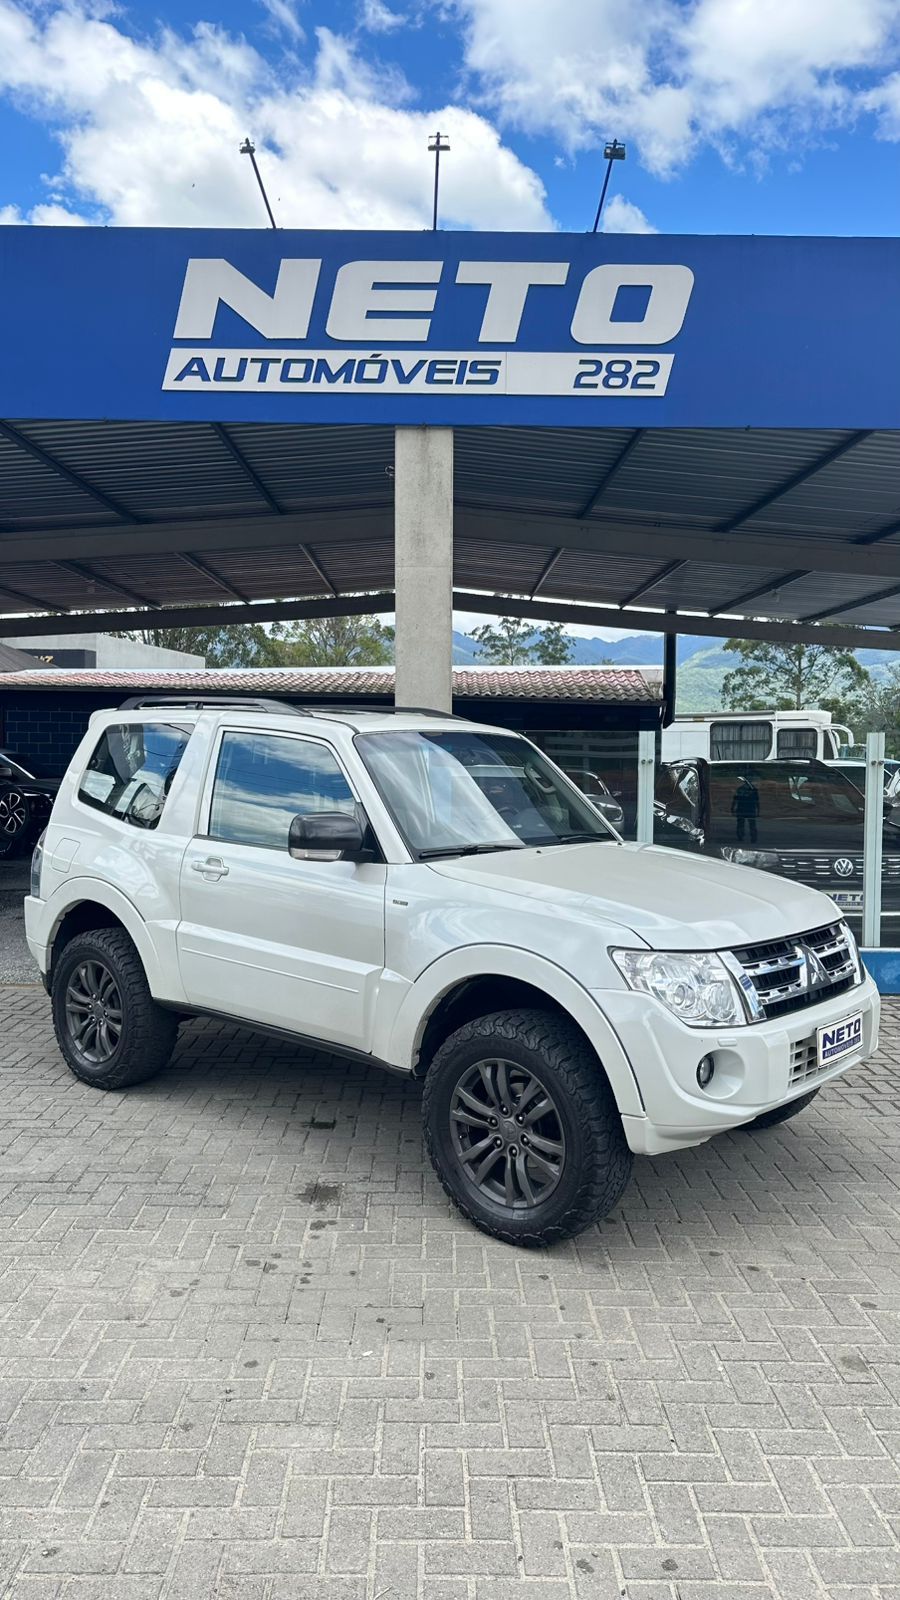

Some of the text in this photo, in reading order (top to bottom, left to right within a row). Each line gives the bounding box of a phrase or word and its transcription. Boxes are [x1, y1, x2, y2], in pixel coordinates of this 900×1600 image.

[173, 258, 695, 345] NETO
[174, 353, 660, 390] AUTOMÓVEIS 282
[826, 893, 863, 902] NET
[822, 1017, 861, 1049] NETO
